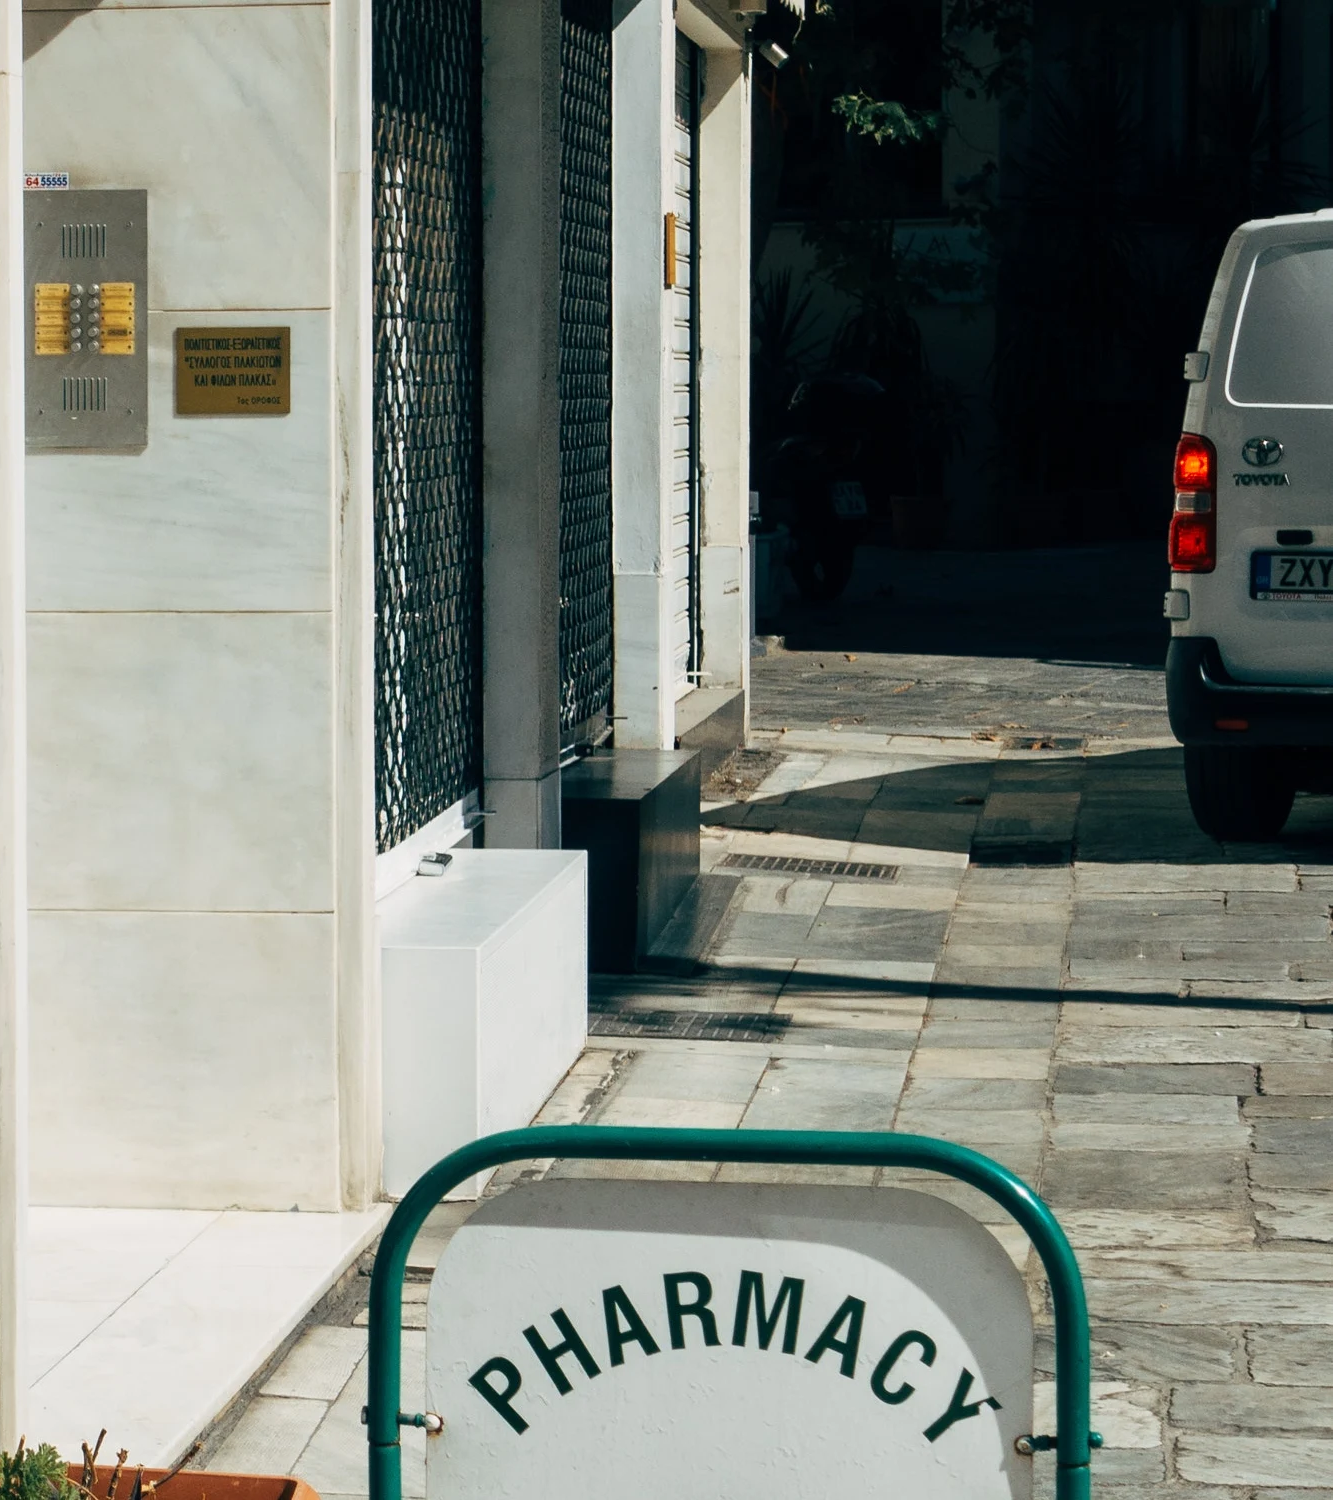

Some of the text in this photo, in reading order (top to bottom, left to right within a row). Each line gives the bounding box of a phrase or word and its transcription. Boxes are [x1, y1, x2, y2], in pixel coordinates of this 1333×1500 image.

[25, 176, 68, 187] 64 55555
[194, 374, 208, 387] ΚΑΙ
[210, 374, 237, 387] ΦΙΛΩΝ
[251, 396, 282, 405] ΟΡΟΦΟΣ
[1232, 473, 1291, 486] TOYOTA
[1273, 592, 1301, 600] TOYOTA
[467, 1269, 1004, 1443] PHARMACY
